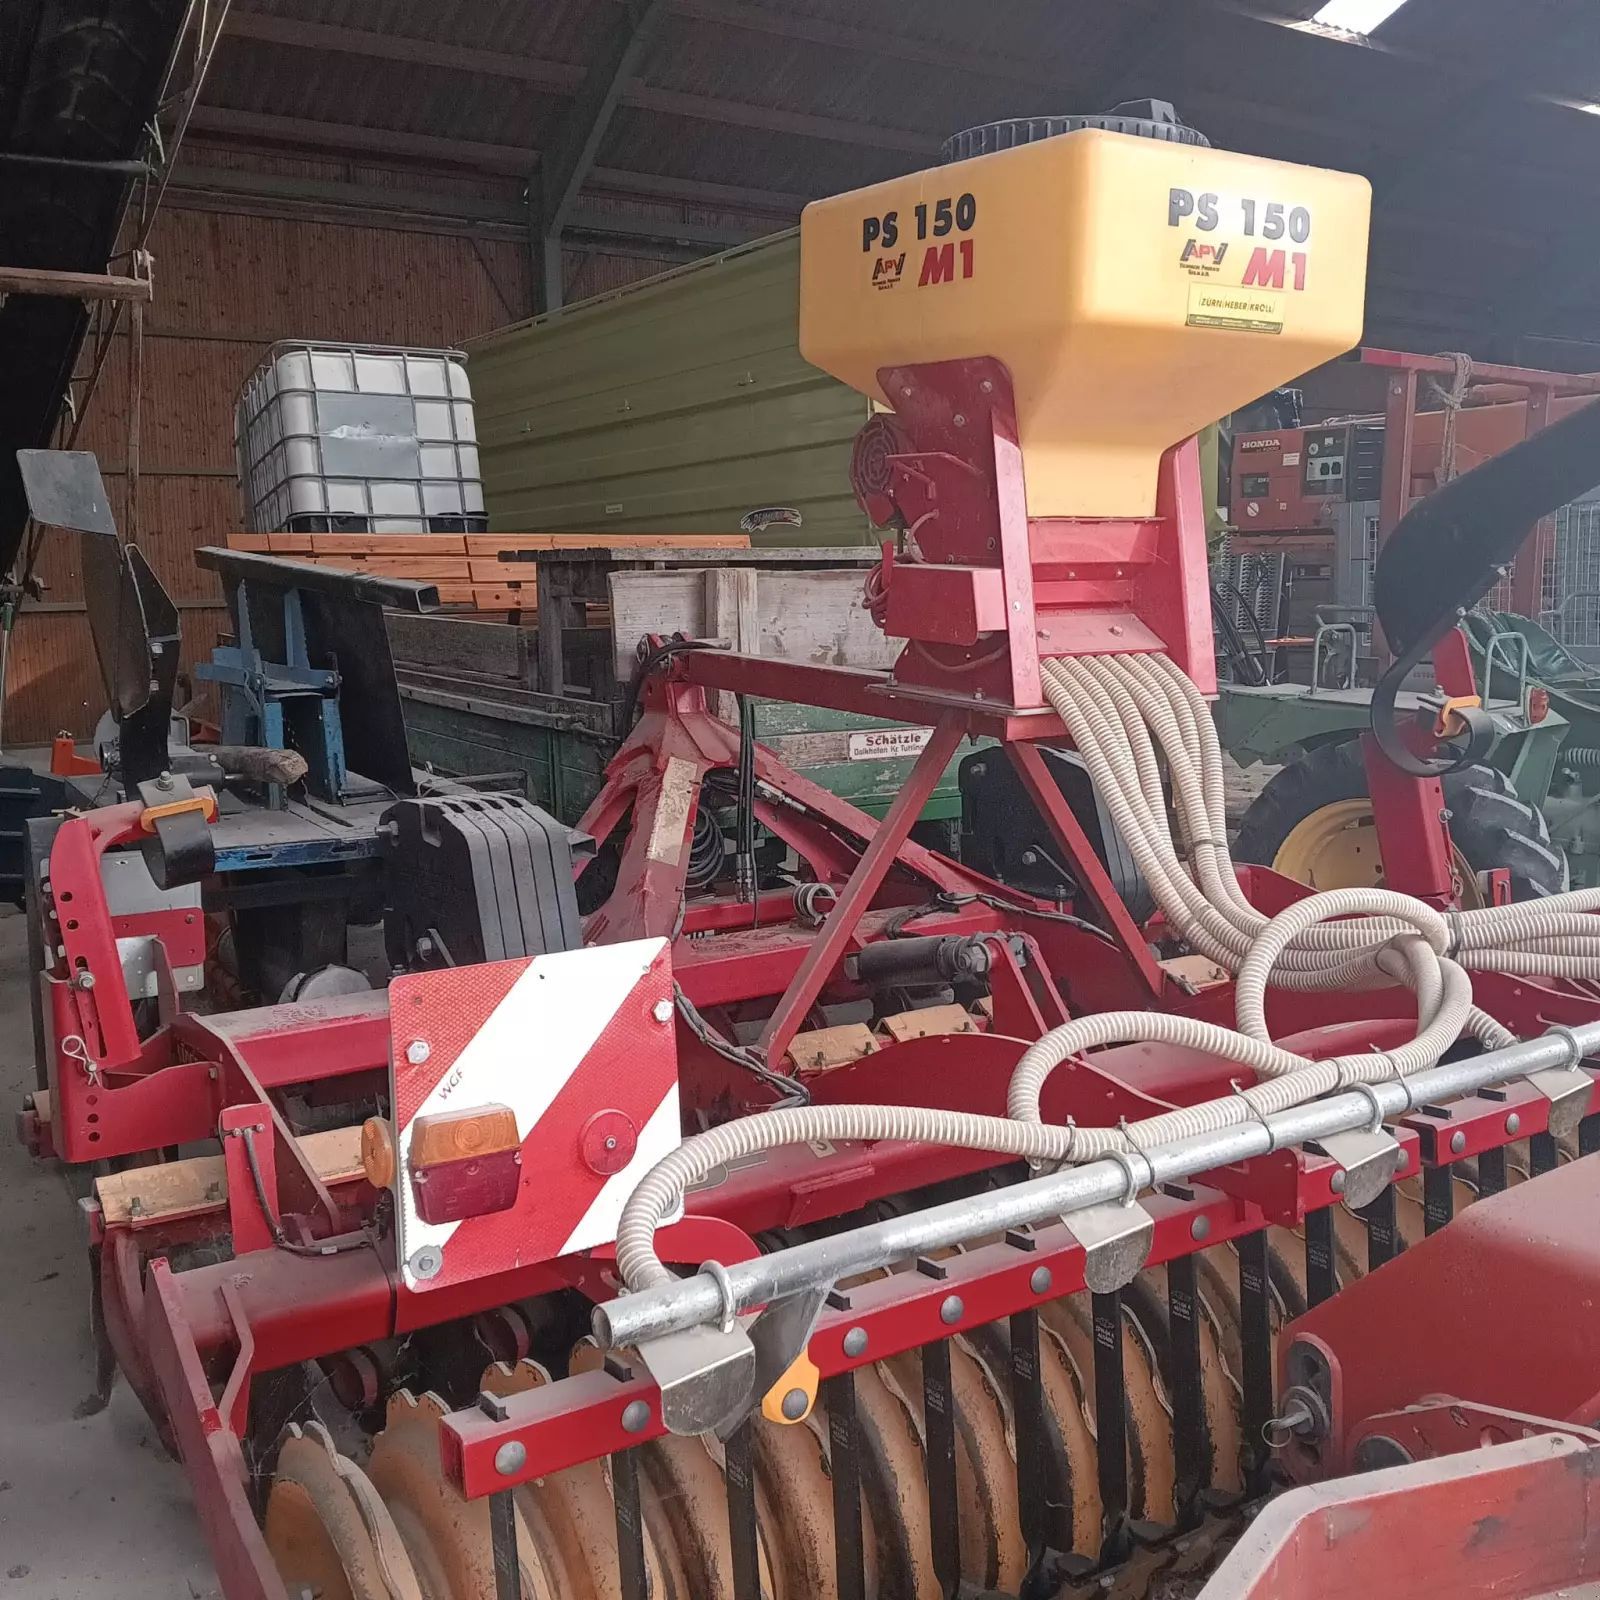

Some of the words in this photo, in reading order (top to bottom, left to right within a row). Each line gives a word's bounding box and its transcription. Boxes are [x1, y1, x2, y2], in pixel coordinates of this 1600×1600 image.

[863, 211, 898, 253] PS
[915, 193, 976, 240] 150
[1168, 188, 1218, 231] PS
[1241, 199, 1310, 243] 150
[918, 239, 973, 287] M1
[1241, 247, 1306, 291] M1
[1242, 439, 1280, 448] HONDA
